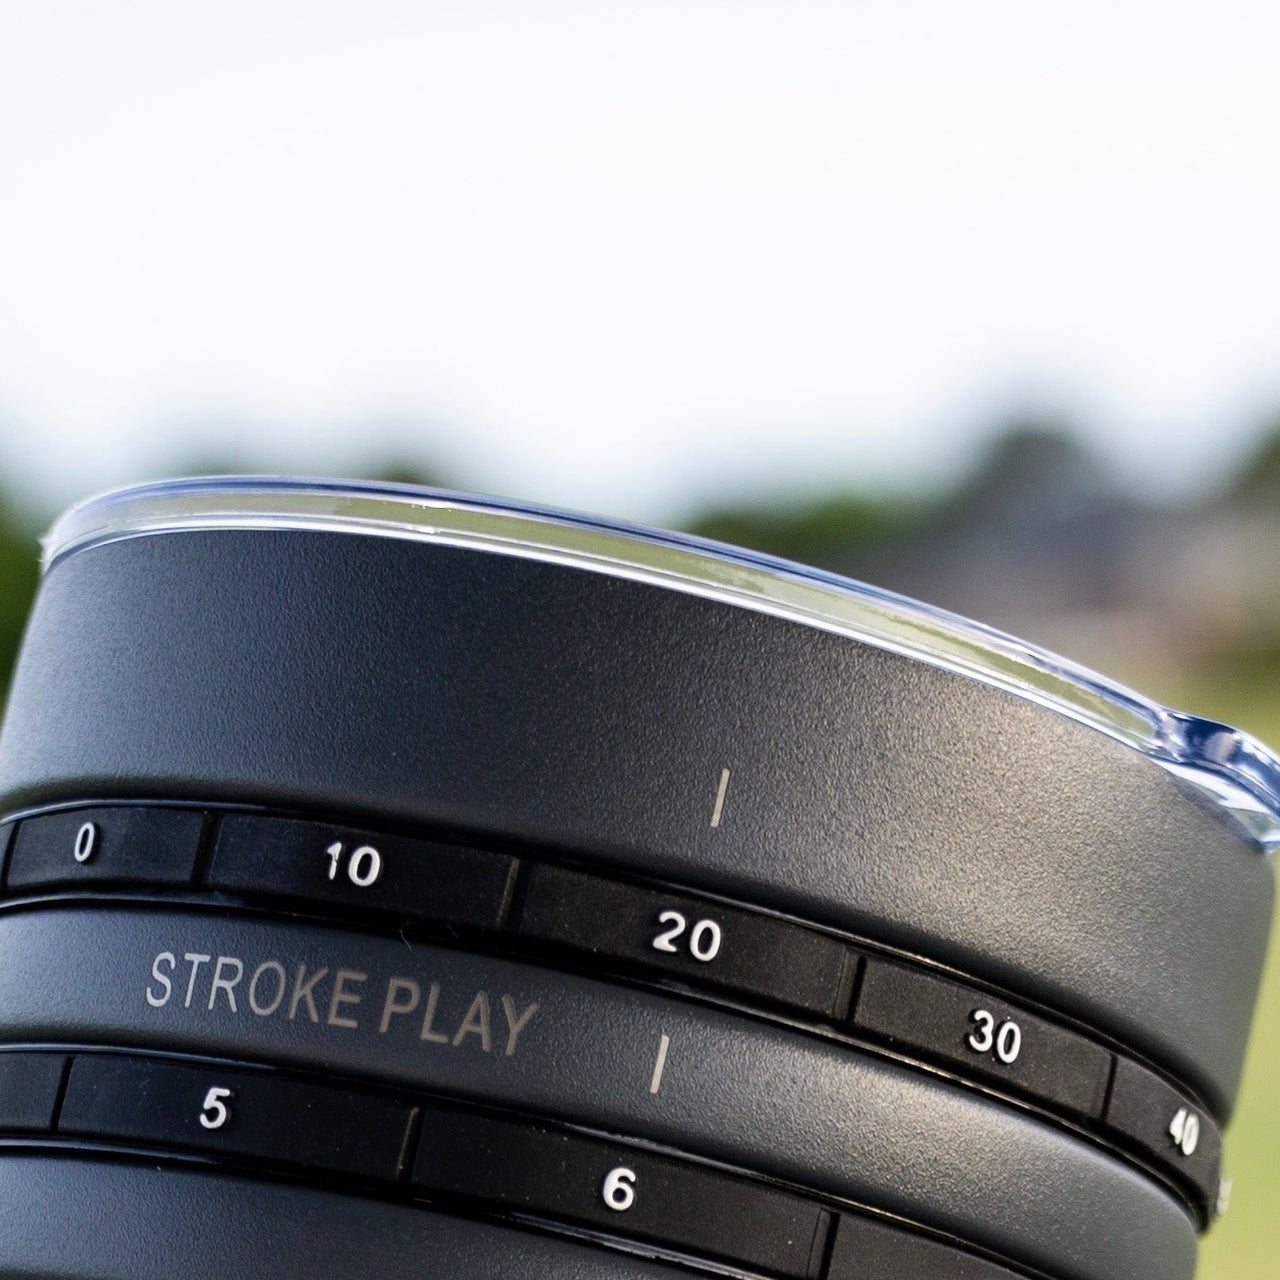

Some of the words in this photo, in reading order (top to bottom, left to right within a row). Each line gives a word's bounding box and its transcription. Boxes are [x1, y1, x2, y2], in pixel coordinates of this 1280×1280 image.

[74, 822, 96, 862] 0
[326, 842, 383, 886] 10
[653, 911, 721, 962] 20
[968, 1009, 1021, 1063] 30
[1169, 1108, 1199, 1156] 40
[146, 951, 367, 1029] STROKE
[379, 977, 539, 1055] PLAY
[199, 1087, 232, 1128] 5
[603, 1167, 636, 1210] 6
